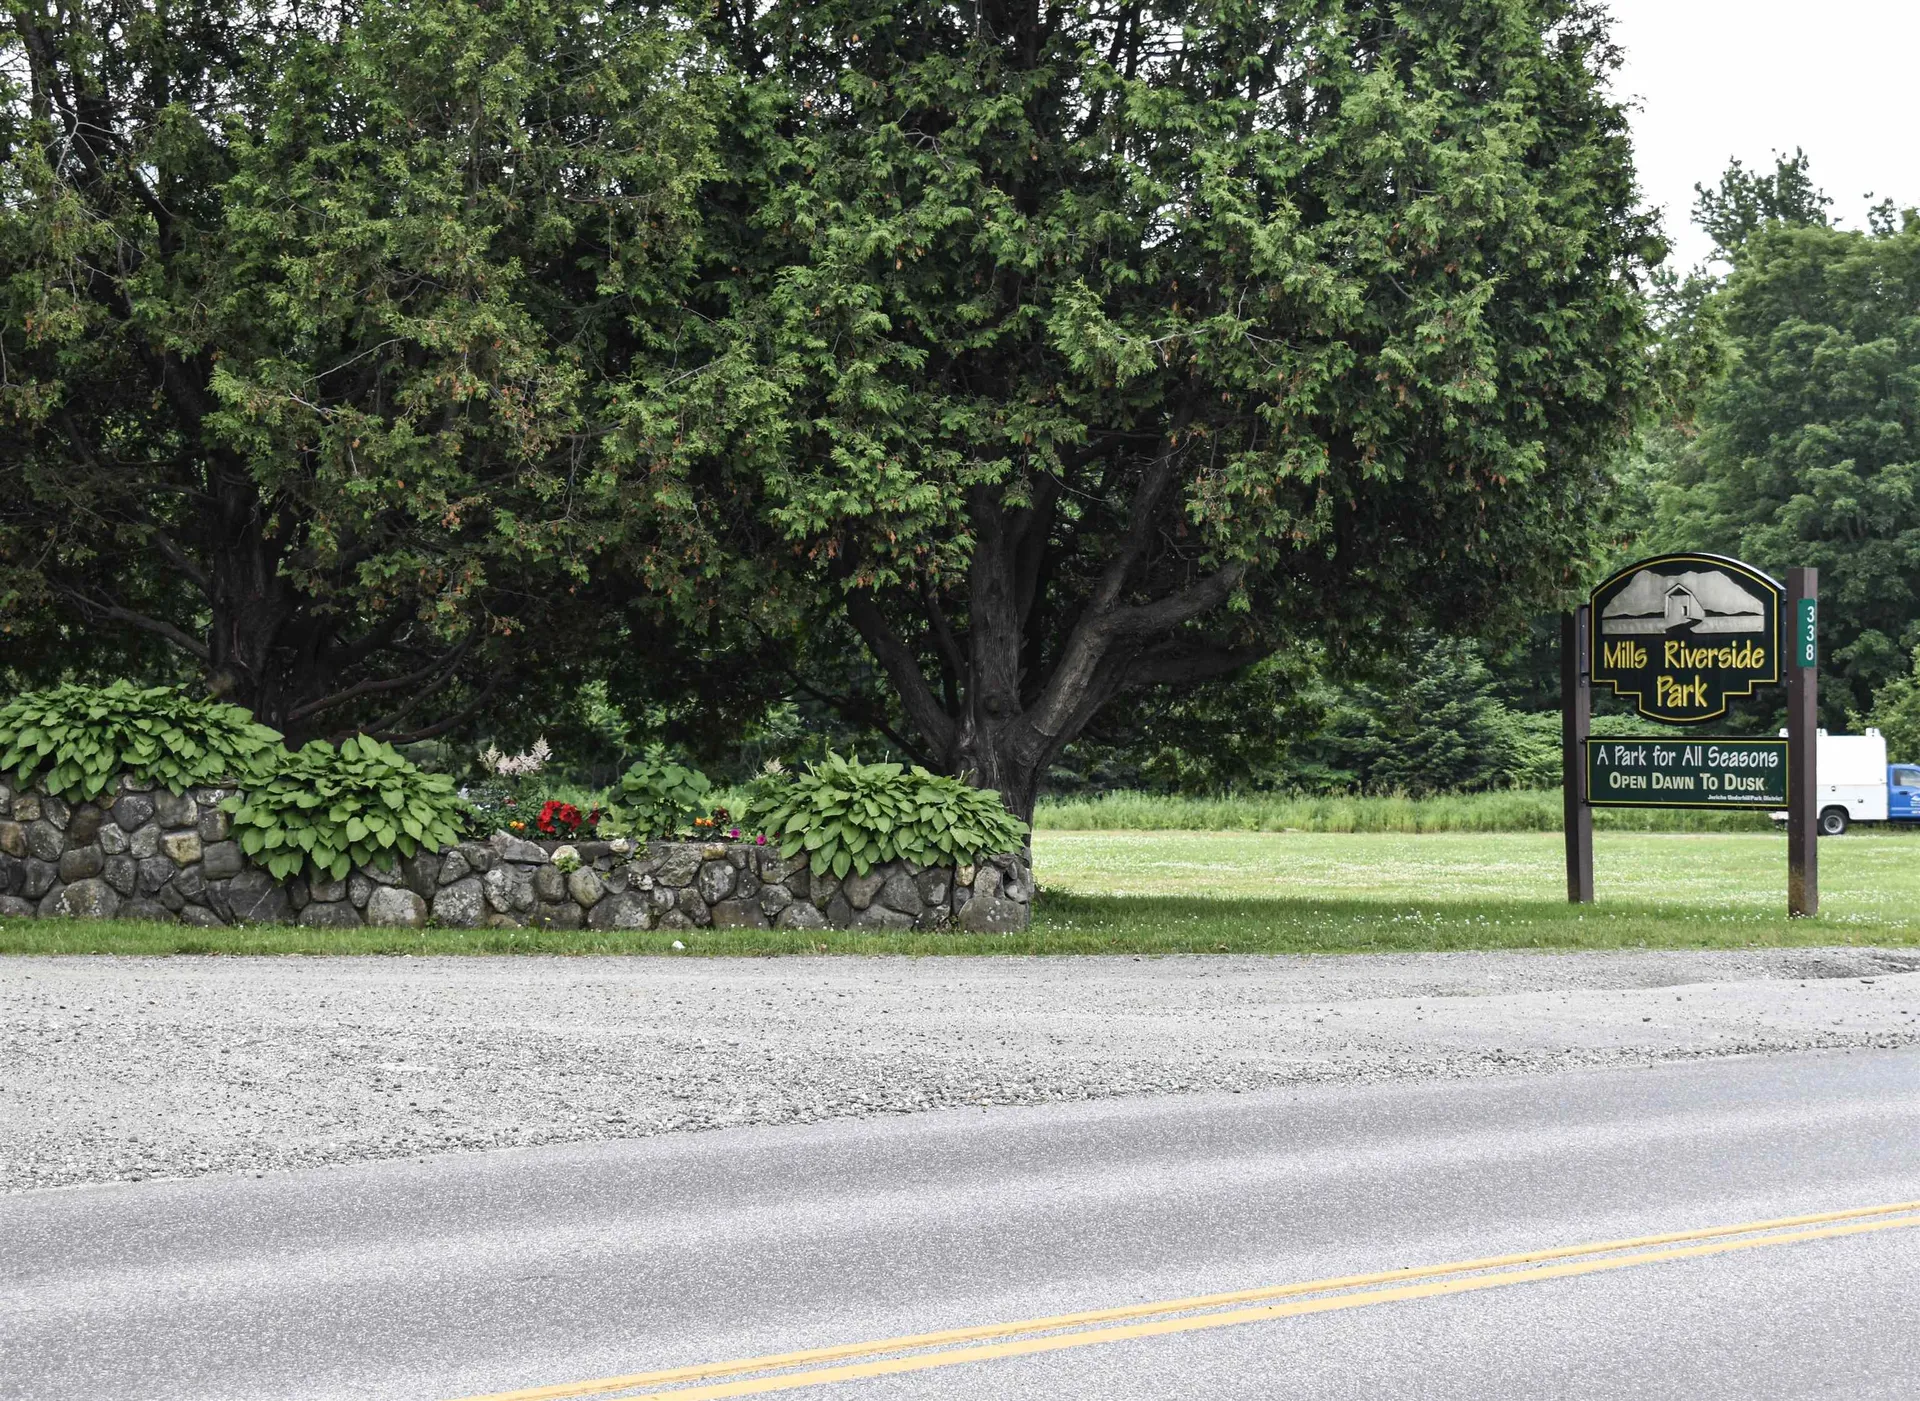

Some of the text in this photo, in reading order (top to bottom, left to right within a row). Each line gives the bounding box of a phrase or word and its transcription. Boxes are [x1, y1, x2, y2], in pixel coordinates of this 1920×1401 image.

[1805, 606, 1815, 661] 338
[1603, 640, 1765, 669] Mills Riverside
[1656, 674, 1708, 708] Park
[1596, 745, 1779, 768] A Park for All Seasons
